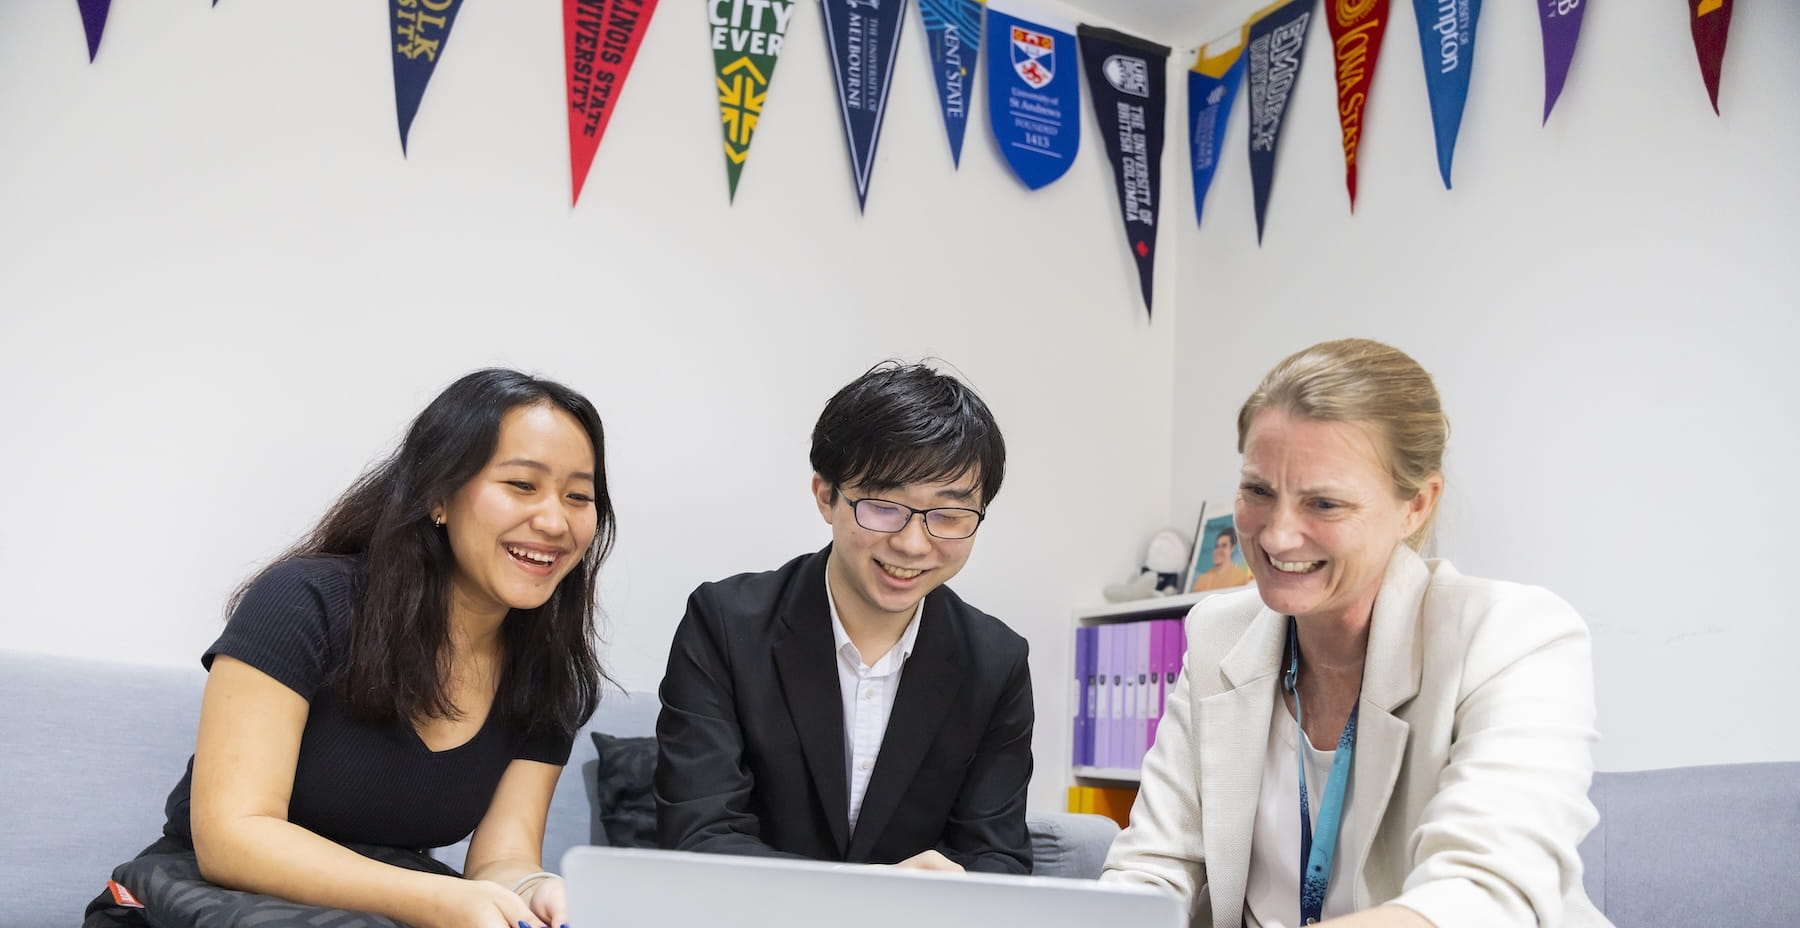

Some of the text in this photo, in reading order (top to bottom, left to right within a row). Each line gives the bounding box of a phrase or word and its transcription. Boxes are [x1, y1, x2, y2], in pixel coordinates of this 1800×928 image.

[708, 0, 794, 34] CITY
[712, 27, 784, 56] EVER
[848, 12, 862, 110] MELBOURNE
[868, 18, 878, 112] THE UNIVERSITY OF
[1336, 19, 1379, 99] IOWA
[583, 0, 644, 137] INOIS STATE
[944, 23, 964, 119] KENT STATE
[1133, 61, 1146, 93] UBC
[1264, 12, 1310, 152] EMORY
[1117, 101, 1139, 222] BRITISH COLUMBIA
[1131, 105, 1152, 226] THE UNIVERSITY OF
